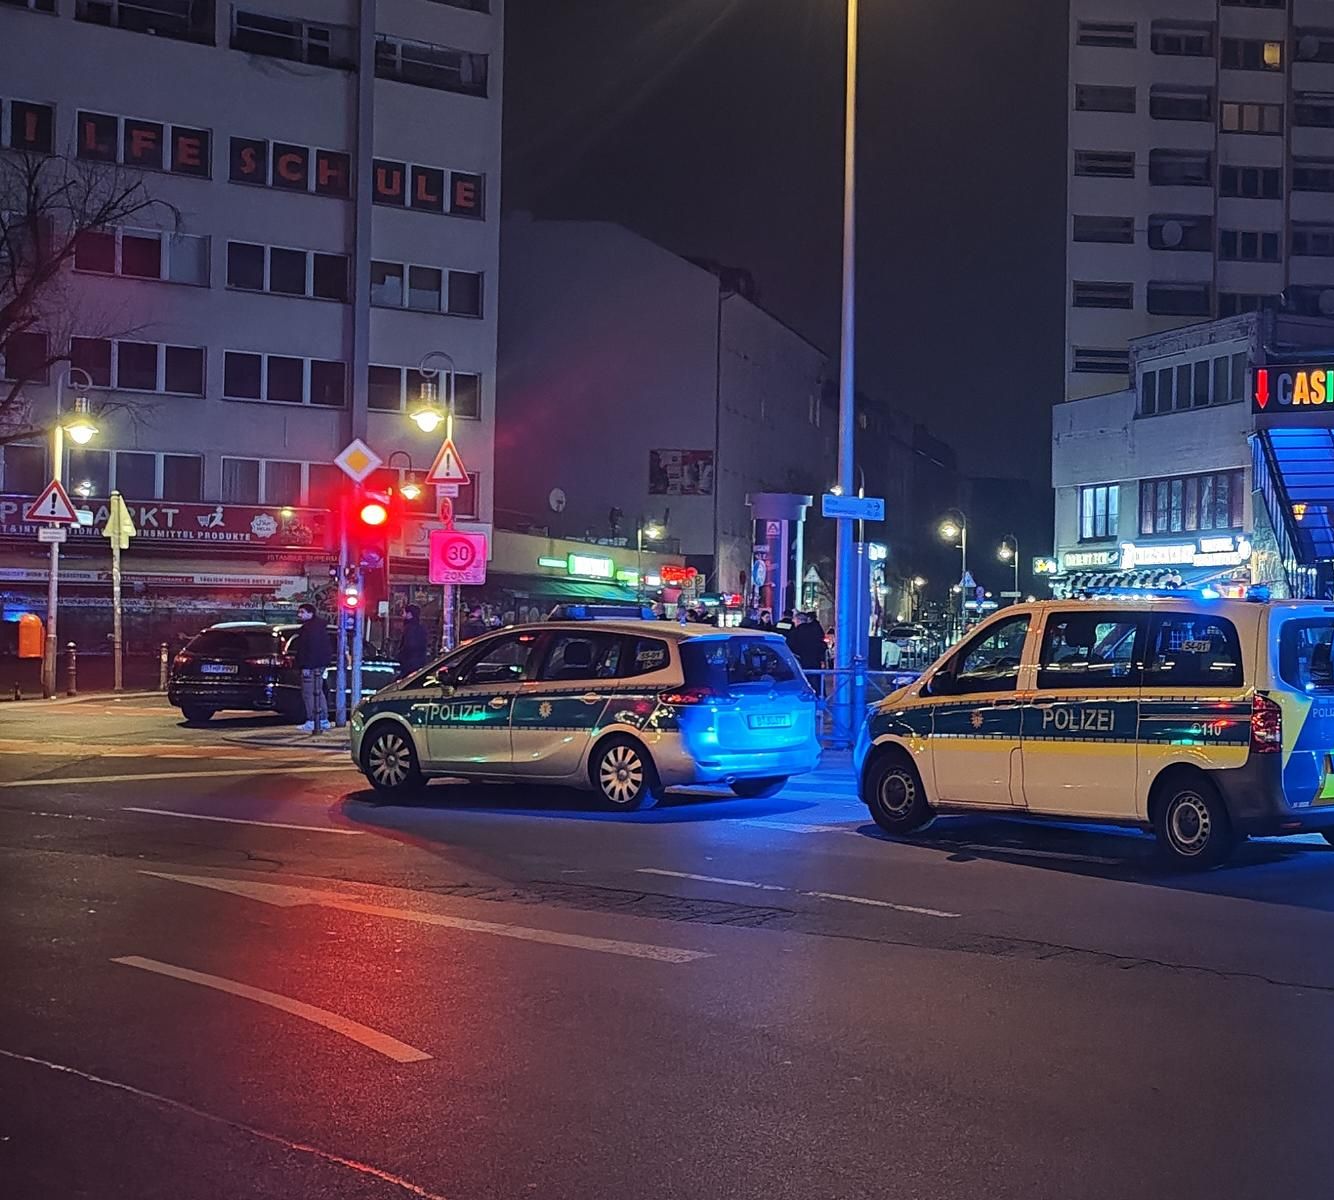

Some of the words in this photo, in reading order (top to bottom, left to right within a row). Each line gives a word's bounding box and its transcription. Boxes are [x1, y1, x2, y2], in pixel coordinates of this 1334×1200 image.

[240, 146, 477, 209] SCHULE
[197, 531, 251, 541] PRODUKTE
[448, 546, 470, 562] 30
[443, 571, 472, 581] ZONE
[430, 704, 487, 721] POLIZEI
[1042, 708, 1115, 731] POLIZEI
[1202, 722, 1222, 736] 110
